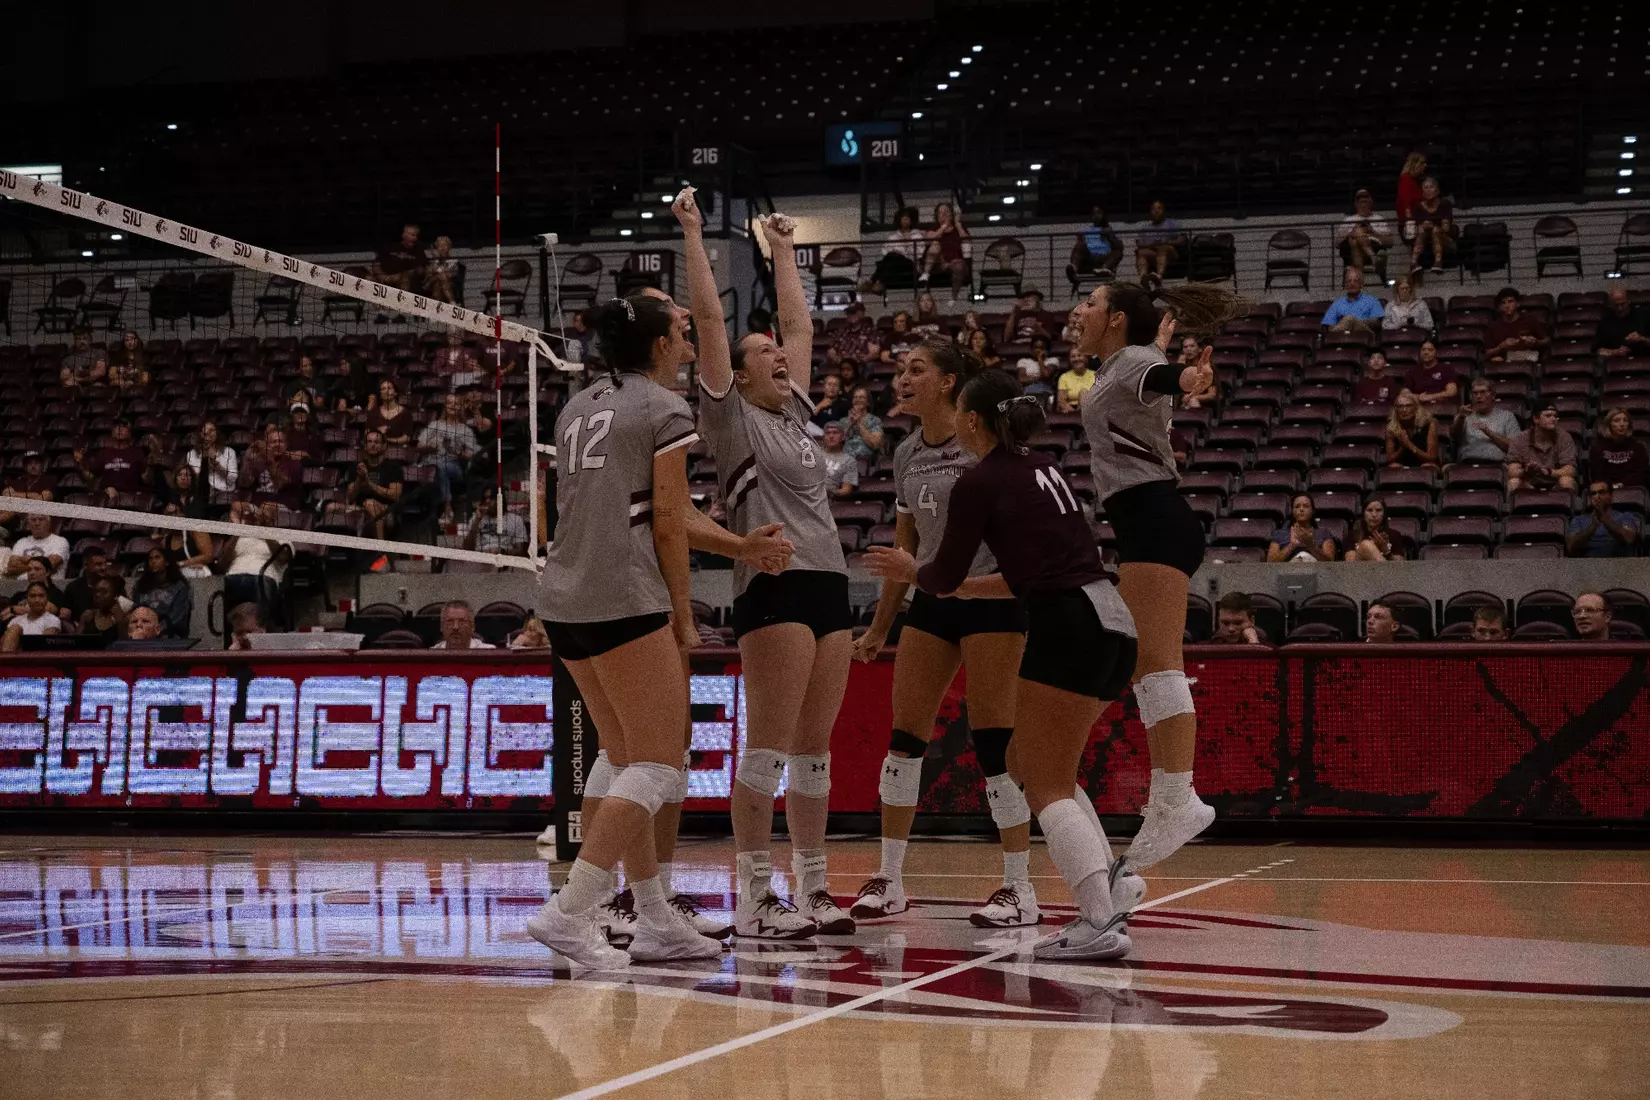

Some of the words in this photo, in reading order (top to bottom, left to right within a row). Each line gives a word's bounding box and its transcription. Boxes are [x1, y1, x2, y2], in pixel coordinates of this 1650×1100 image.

[692, 147, 719, 165] 216
[871, 139, 898, 158] 201
[60, 190, 82, 210] SIU
[122, 209, 143, 228] SIU
[179, 227, 199, 244] SIU
[233, 242, 252, 258] SIU
[283, 257, 300, 274] SIU
[328, 271, 345, 287] SIU
[372, 283, 387, 299] SIU
[413, 295, 427, 311] SIU
[451, 307, 466, 321] SIU
[637, 253, 662, 272] 116
[796, 248, 814, 267] 01
[562, 408, 616, 476] 12
[799, 436, 817, 470] 8
[917, 482, 939, 519] 4
[1034, 465, 1080, 516] 11
[570, 699, 584, 742] sports
[571, 743, 585, 796] imports
